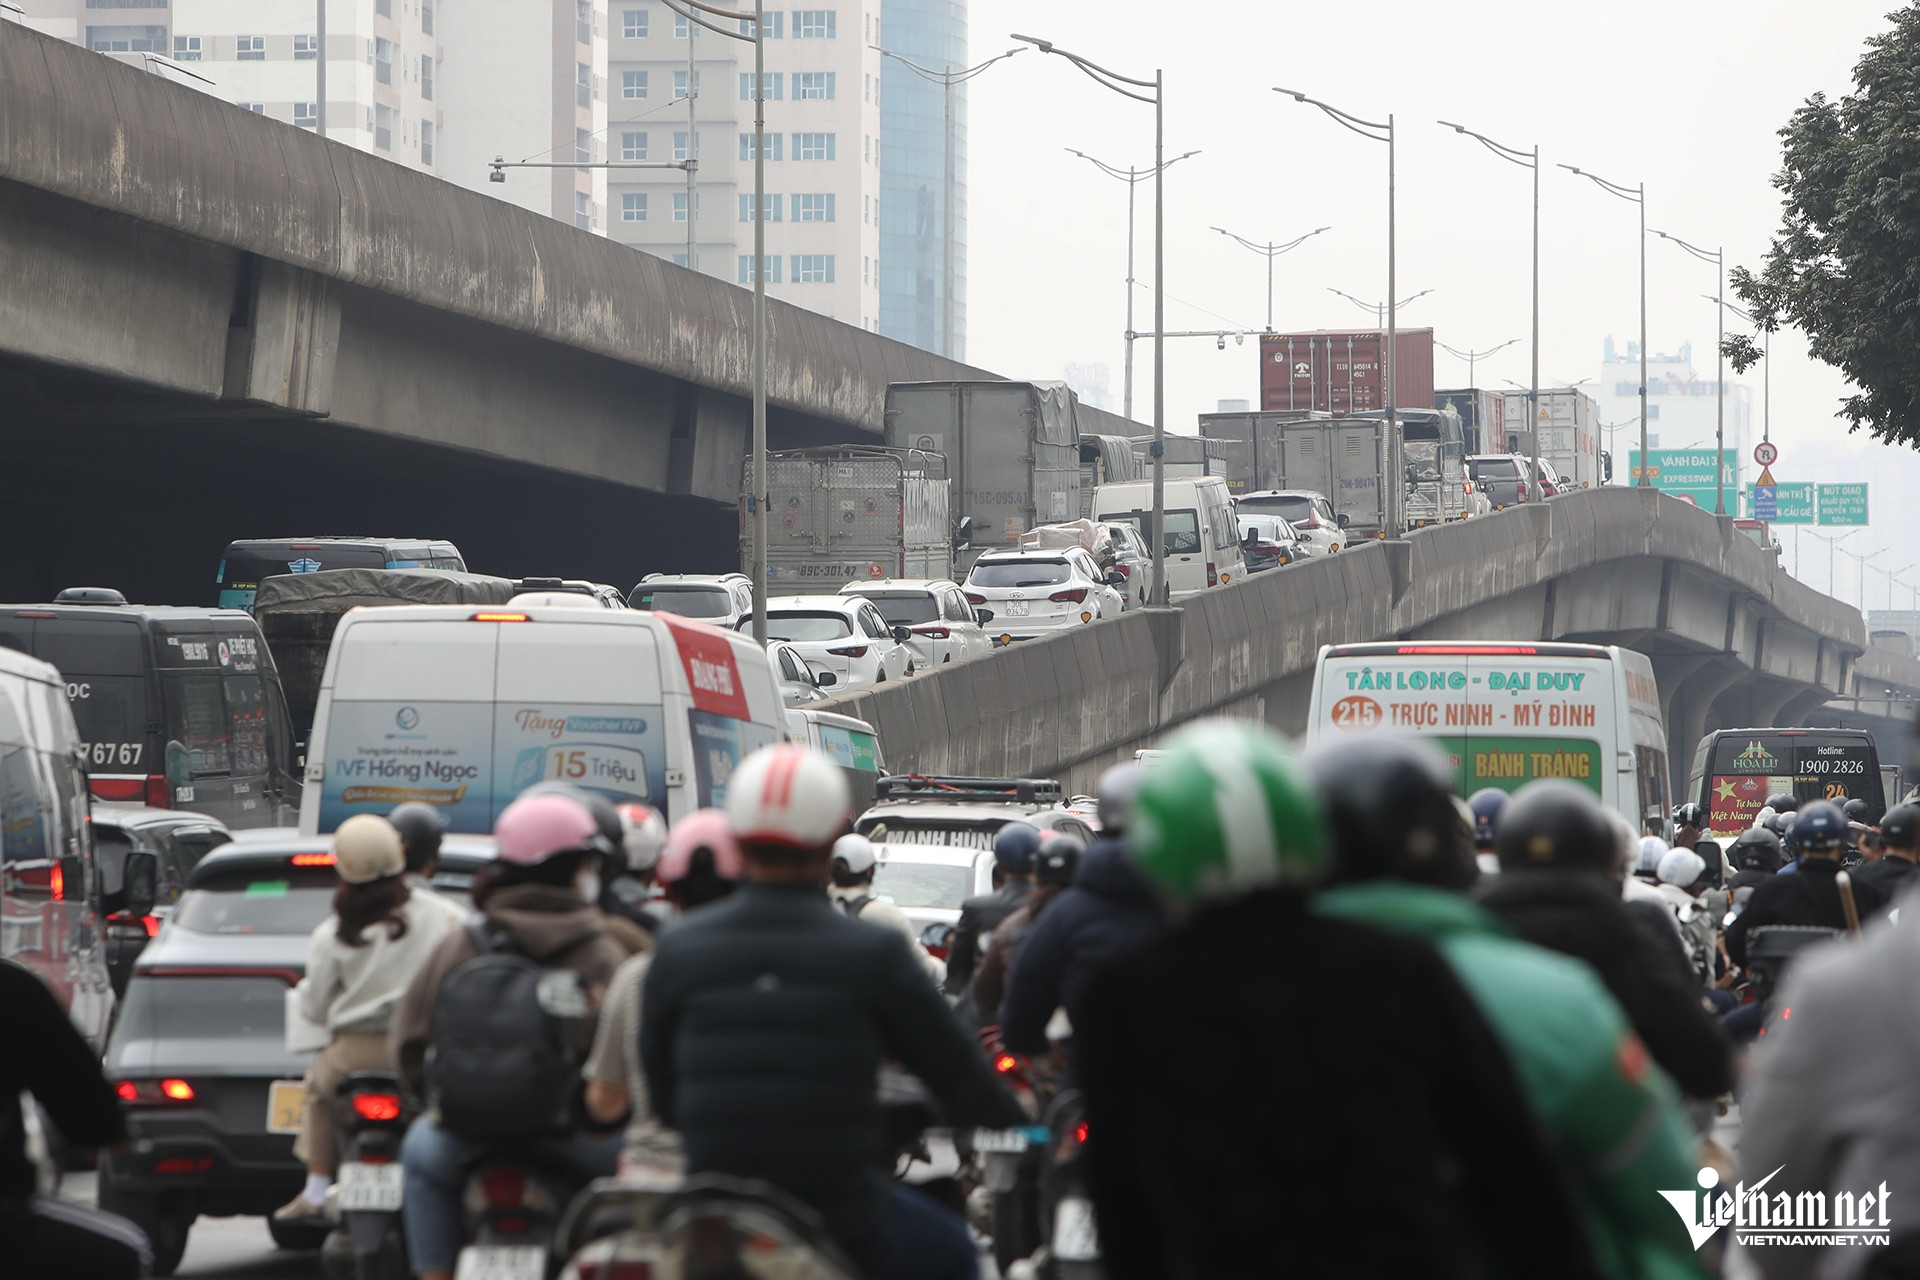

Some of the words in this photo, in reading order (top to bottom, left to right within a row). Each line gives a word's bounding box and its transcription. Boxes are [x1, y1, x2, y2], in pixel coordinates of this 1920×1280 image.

[1664, 474, 1714, 484] EXPRESSWAY
[974, 491, 1028, 504] 15C-095.41
[800, 565, 857, 576] 89C-301.47
[1347, 668, 1391, 690] TÂN
[1398, 672, 1466, 690] LONG
[1489, 672, 1530, 695] ĐẠI
[1538, 672, 1585, 691] DUY
[1338, 702, 1375, 726] 215
[1390, 700, 1438, 730] TRỰC
[1446, 704, 1493, 726] NINH
[1514, 701, 1543, 727] MỸ
[1550, 700, 1595, 727] ĐÌNH
[514, 709, 566, 739] Tặng
[1818, 746, 1844, 755] Hotline:
[554, 751, 587, 778] 15
[590, 757, 636, 783] Triệu
[1475, 748, 1525, 778] BÁNH
[1530, 748, 1590, 778] TRÁNG
[1800, 760, 1830, 774] 1900
[1833, 760, 1864, 774] 2826
[336, 759, 365, 776] IVF
[425, 761, 478, 783] Ngọc
[1746, 799, 1762, 808] hào
[1710, 811, 1728, 820] Việt
[1729, 812, 1753, 820] Nam
